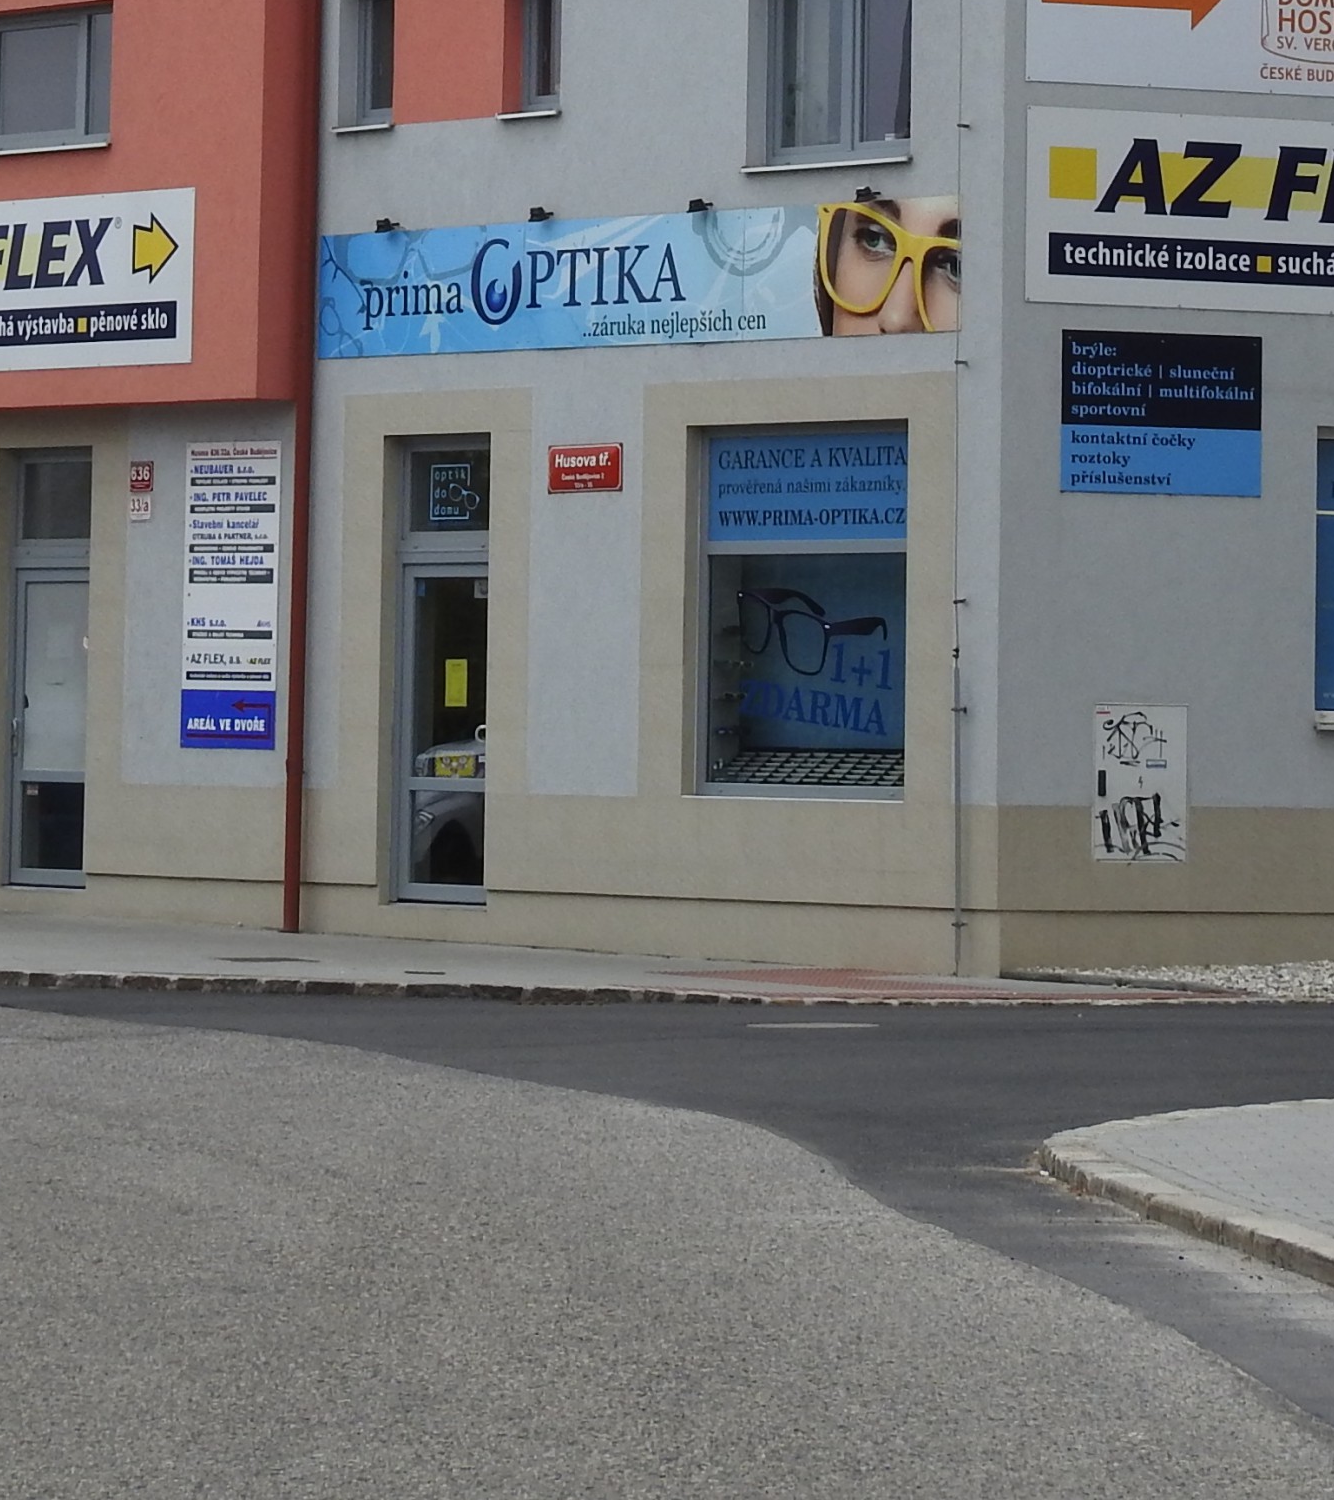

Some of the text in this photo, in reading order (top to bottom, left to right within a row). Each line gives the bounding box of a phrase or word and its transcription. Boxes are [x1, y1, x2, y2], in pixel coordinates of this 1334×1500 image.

[1276, 36, 1297, 50] SV.
[1260, 63, 1302, 81] ČESKÉ
[1094, 138, 1242, 219] AZ
[1064, 241, 1169, 269] technické
[1176, 245, 1251, 272] izolace
[362, 238, 685, 331] prima OPTIKA
[17, 313, 75, 341] výstavba
[90, 310, 138, 337] pěnové
[141, 307, 168, 330] sklo
[651, 309, 733, 337] nejlepších
[737, 313, 767, 331] cen
[1072, 342, 1117, 359] brýle:
[1071, 361, 1235, 380] dioptrické sluneční
[1071, 381, 1255, 401] bifokální multifokální
[1071, 403, 1147, 418] sportovní
[1071, 431, 1196, 450] kontaktní čočky
[555, 452, 611, 468] Husova tř.
[718, 446, 908, 470] GARANCE A KVALITA
[1071, 451, 1131, 468] roztoky
[131, 466, 150, 481] 636
[193, 465, 234, 474] NEUBAUER
[434, 468, 466, 482] optik
[1071, 470, 1171, 486] příslušenství
[434, 487, 447, 498] do
[718, 474, 906, 498] prověřená našimi zákazníky.
[213, 492, 231, 502] PETR
[235, 491, 268, 501] PAVELEC
[434, 503, 460, 515] domu
[718, 507, 906, 526] WWW.PRIMA-OPTIKA.CZ
[192, 519, 223, 529] Stavební
[240, 556, 264, 565] HEJDA
[190, 654, 202, 664] AZ
[830, 642, 893, 690] 1+1
[738, 679, 887, 736] ZDARMA
[187, 714, 265, 731] AREÁL VE DVOŘE
